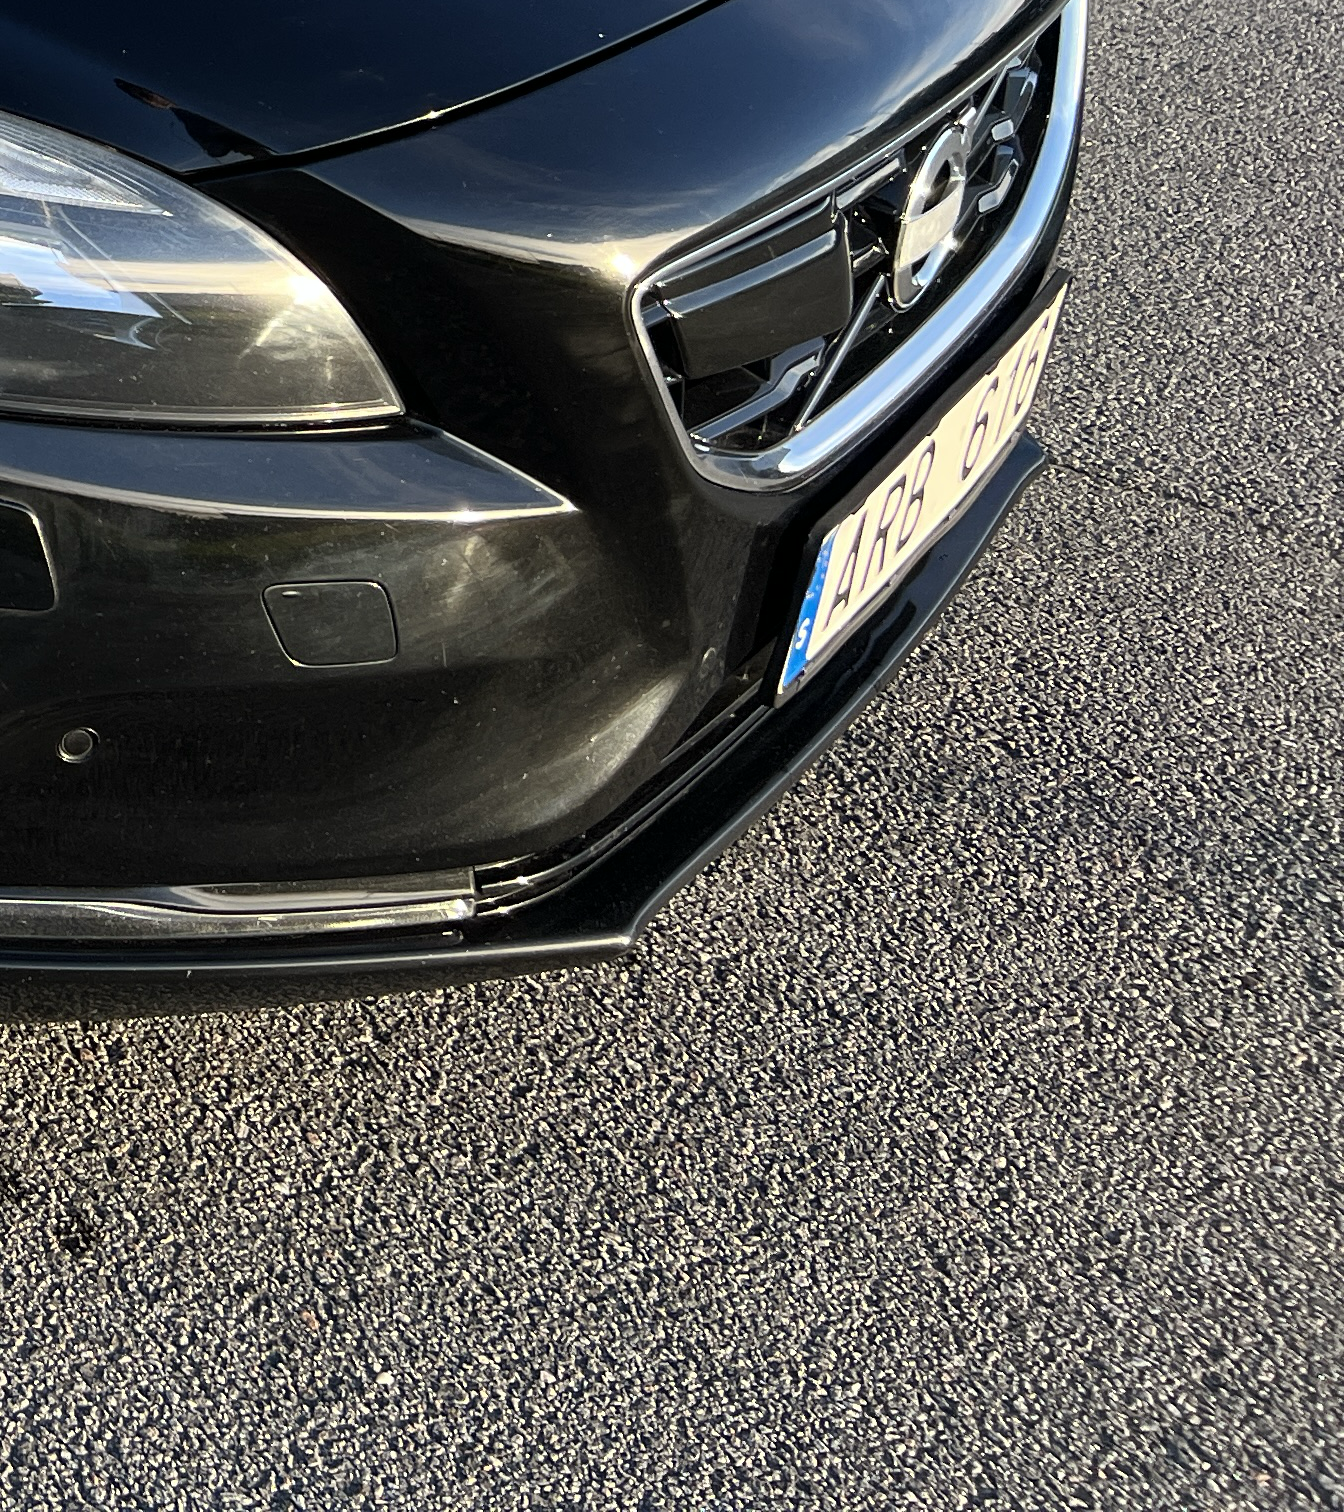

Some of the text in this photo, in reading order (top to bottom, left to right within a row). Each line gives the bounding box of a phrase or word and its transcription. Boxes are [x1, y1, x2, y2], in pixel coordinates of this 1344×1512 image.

[821, 315, 1050, 632] ARB 616
[795, 617, 811, 650] S
